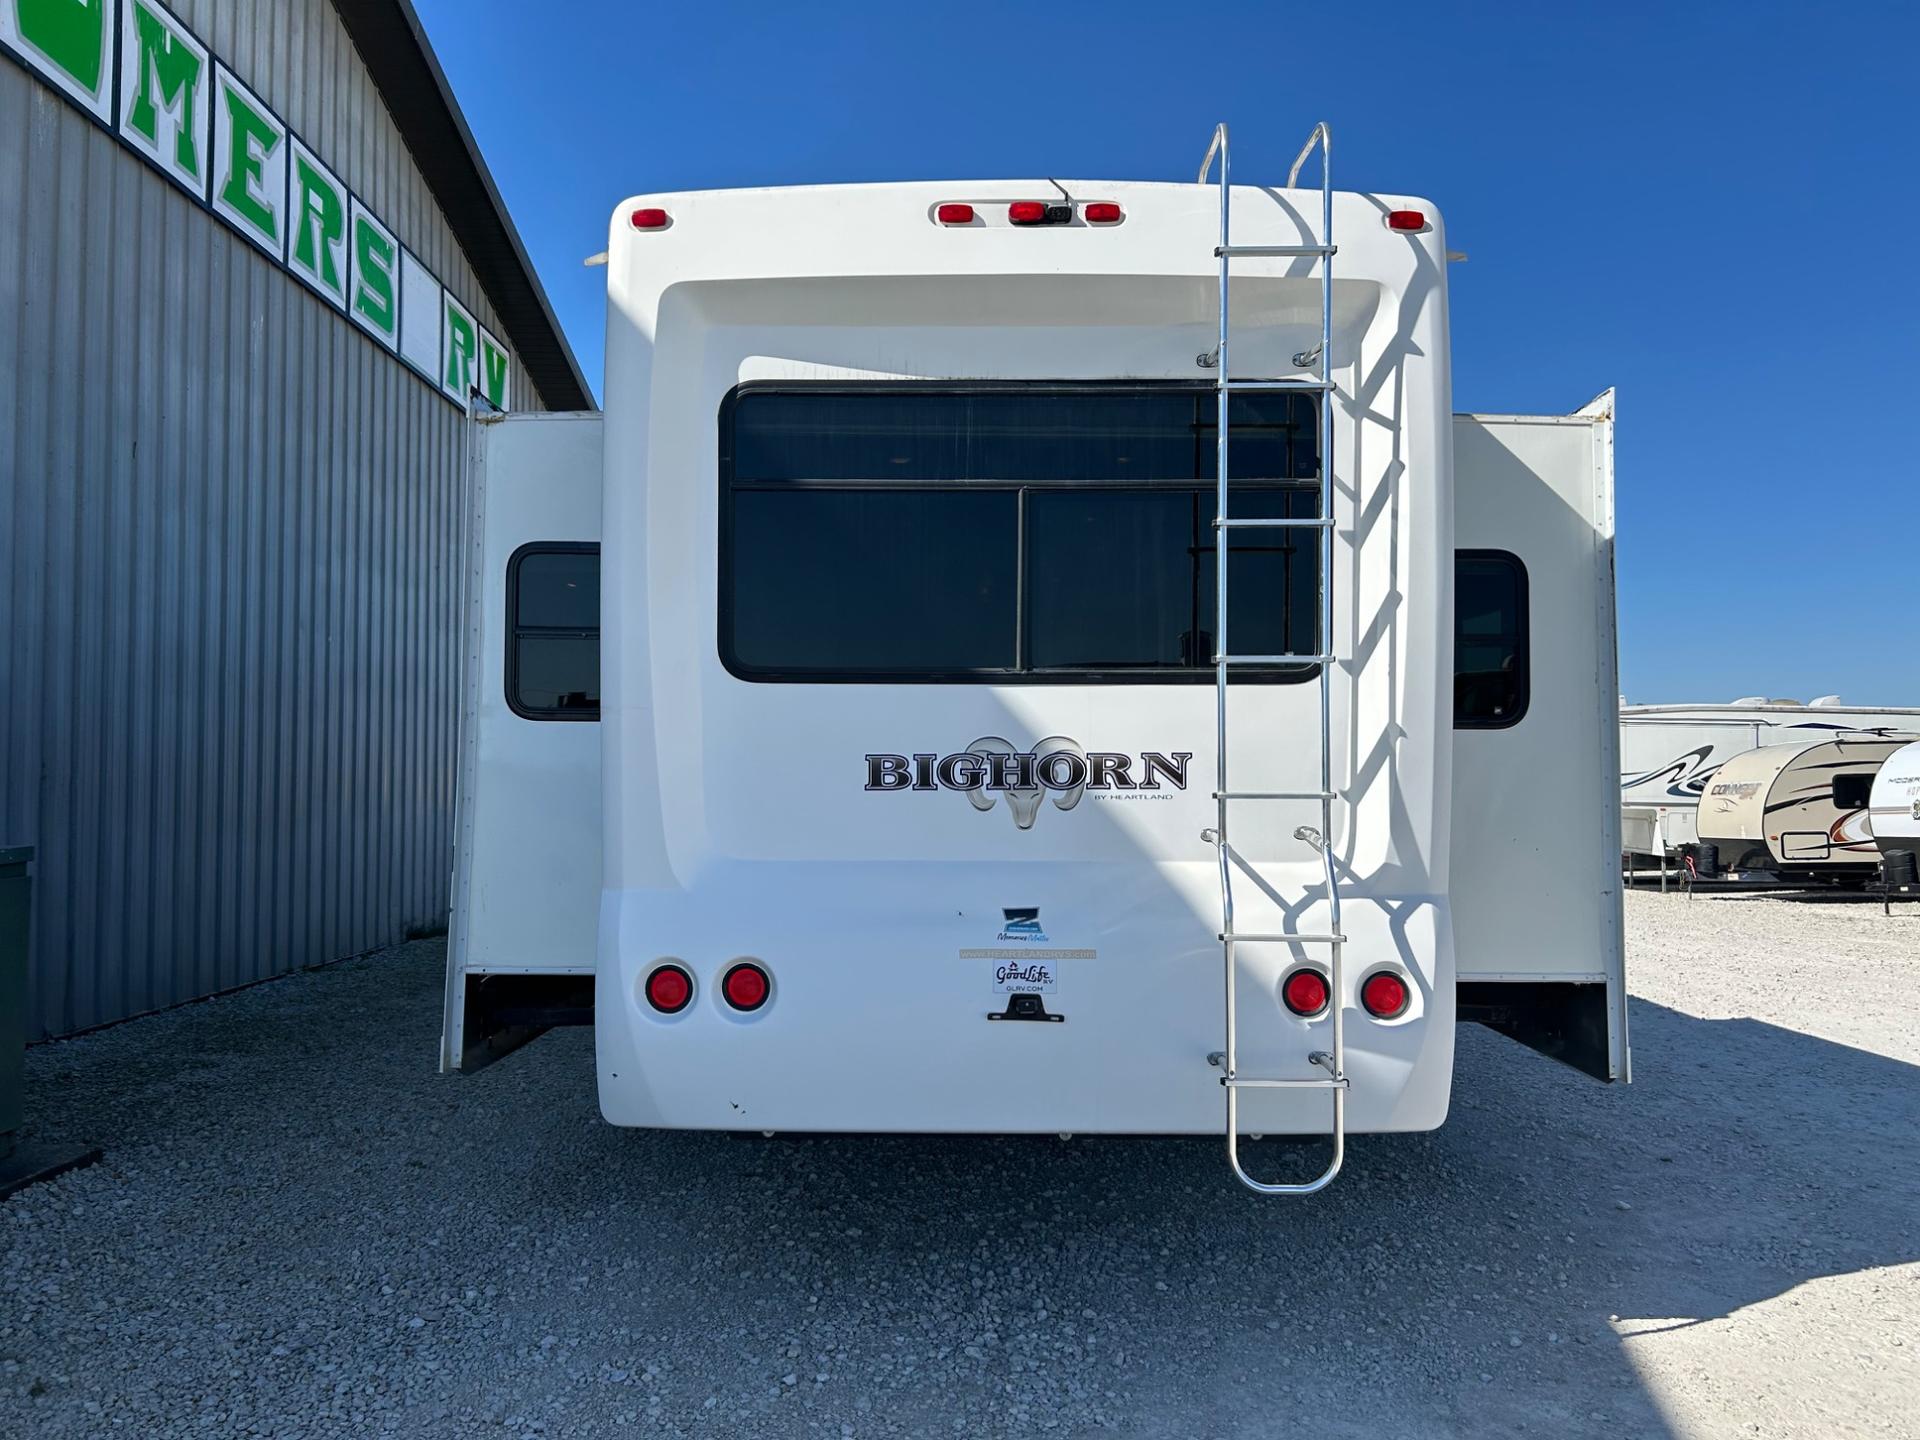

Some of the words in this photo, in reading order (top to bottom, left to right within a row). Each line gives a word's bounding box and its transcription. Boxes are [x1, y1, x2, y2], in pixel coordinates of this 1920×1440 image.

[446, 302, 509, 410] RV
[864, 752, 1193, 791] BIGHORN
[1110, 793, 1173, 801] HEARTLAND
